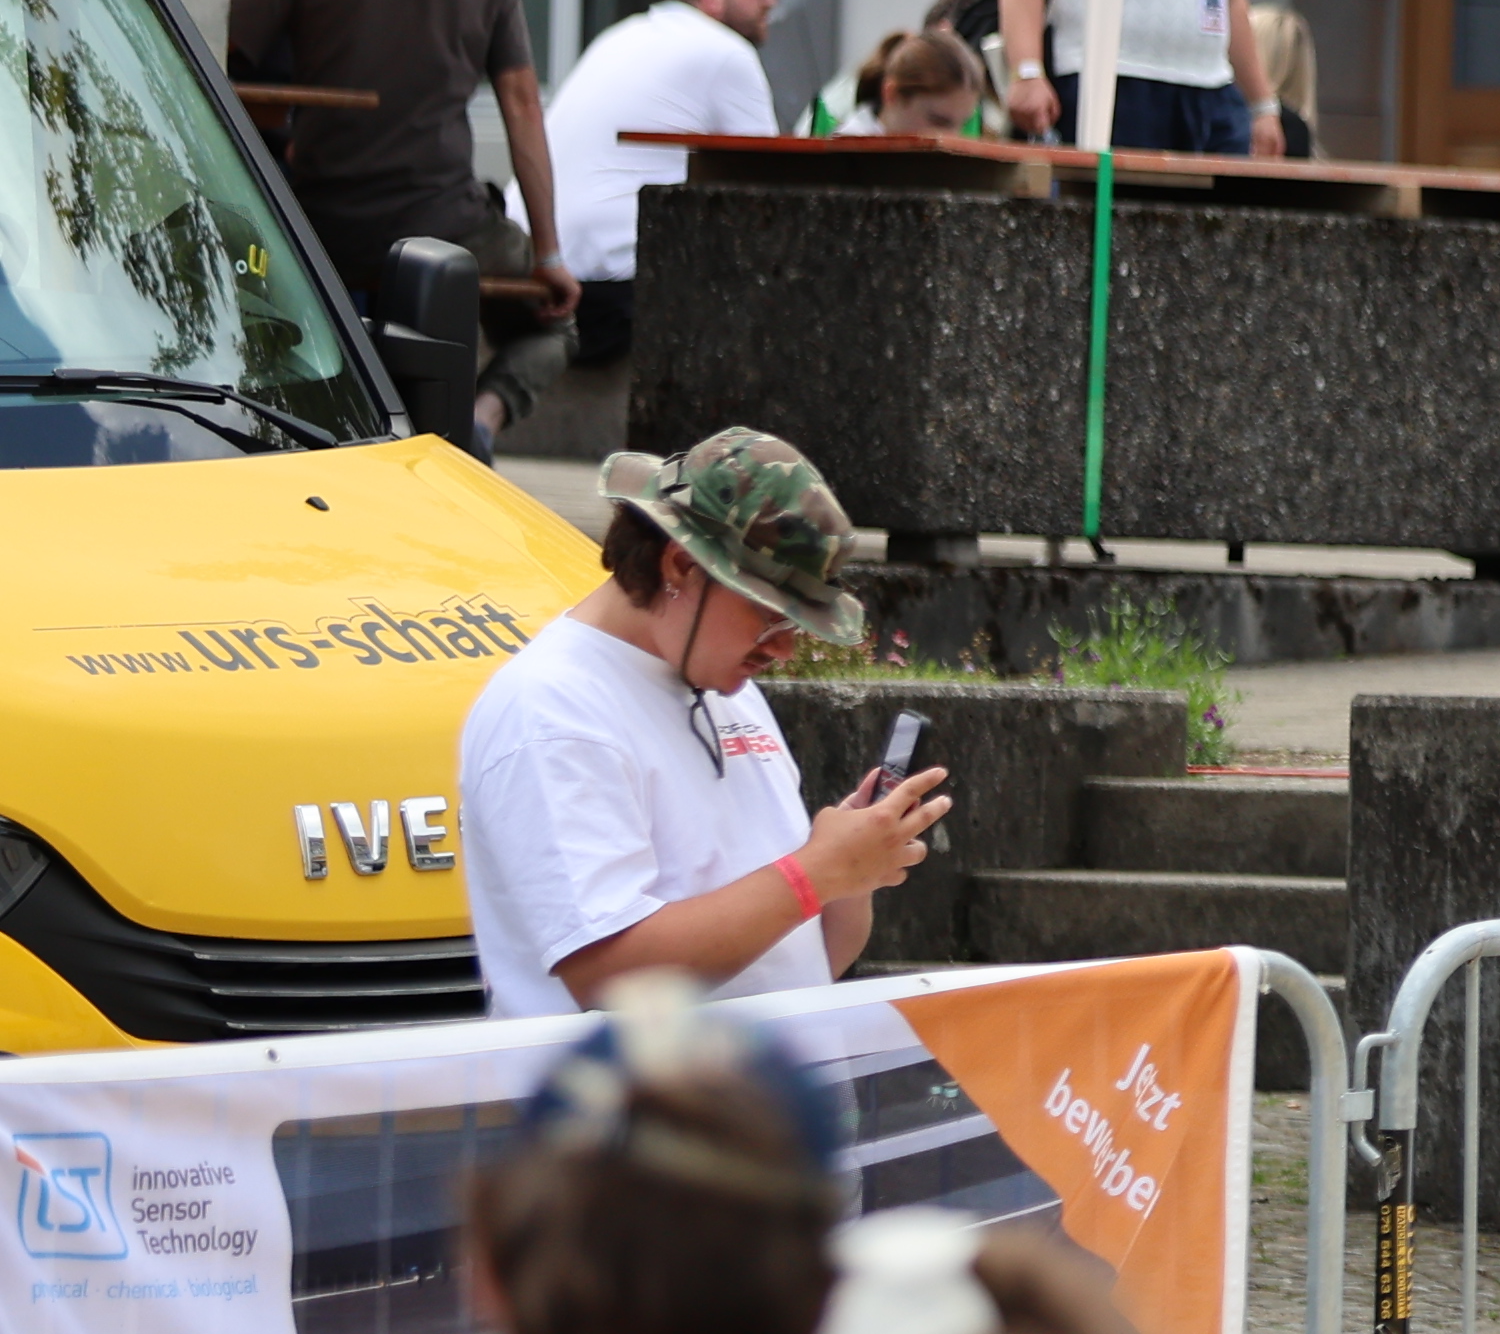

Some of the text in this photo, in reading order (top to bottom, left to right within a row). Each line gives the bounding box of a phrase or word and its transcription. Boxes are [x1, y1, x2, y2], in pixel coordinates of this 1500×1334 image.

[294, 795, 465, 880] IVE
[132, 1161, 236, 1191] innovative
[131, 1198, 212, 1224] Sensor
[137, 1226, 257, 1257] Technology
